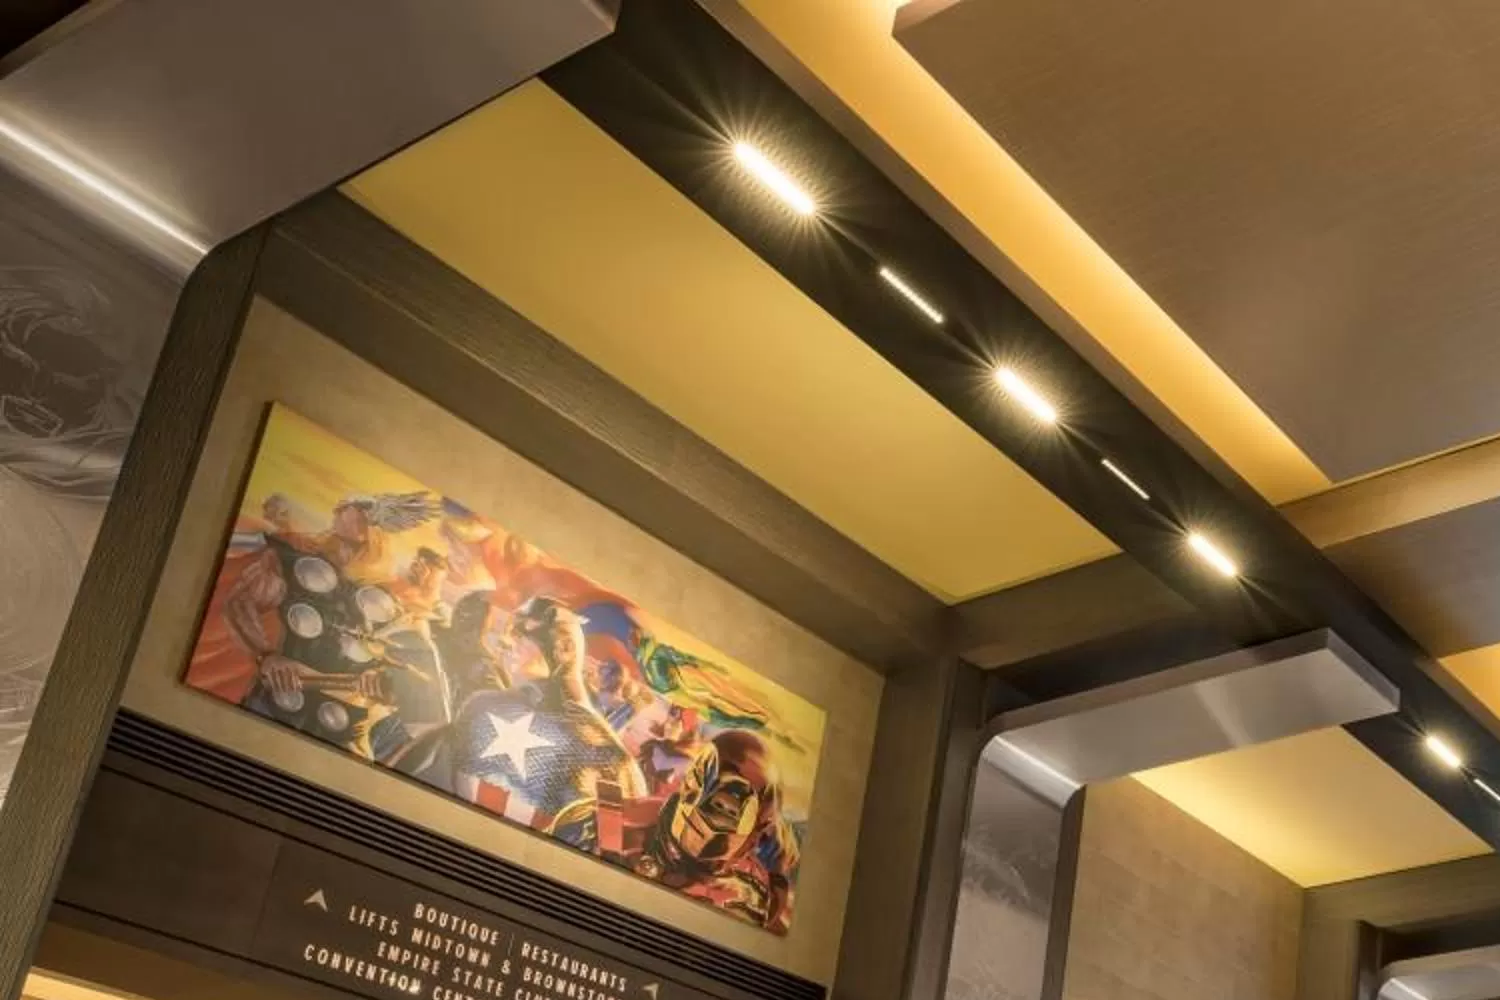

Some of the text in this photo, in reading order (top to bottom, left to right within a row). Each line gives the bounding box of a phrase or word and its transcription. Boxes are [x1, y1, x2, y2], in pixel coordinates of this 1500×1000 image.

[303, 944, 421, 996] CONVENTION
[349, 904, 400, 936] LIFTS
[411, 927, 491, 968] MIDTOWN
[501, 960, 512, 975] &
[377, 941, 441, 976] EMPIRE
[452, 967, 505, 998] STATE
[413, 903, 628, 992] BOUTIQUE RESTAURANTS
